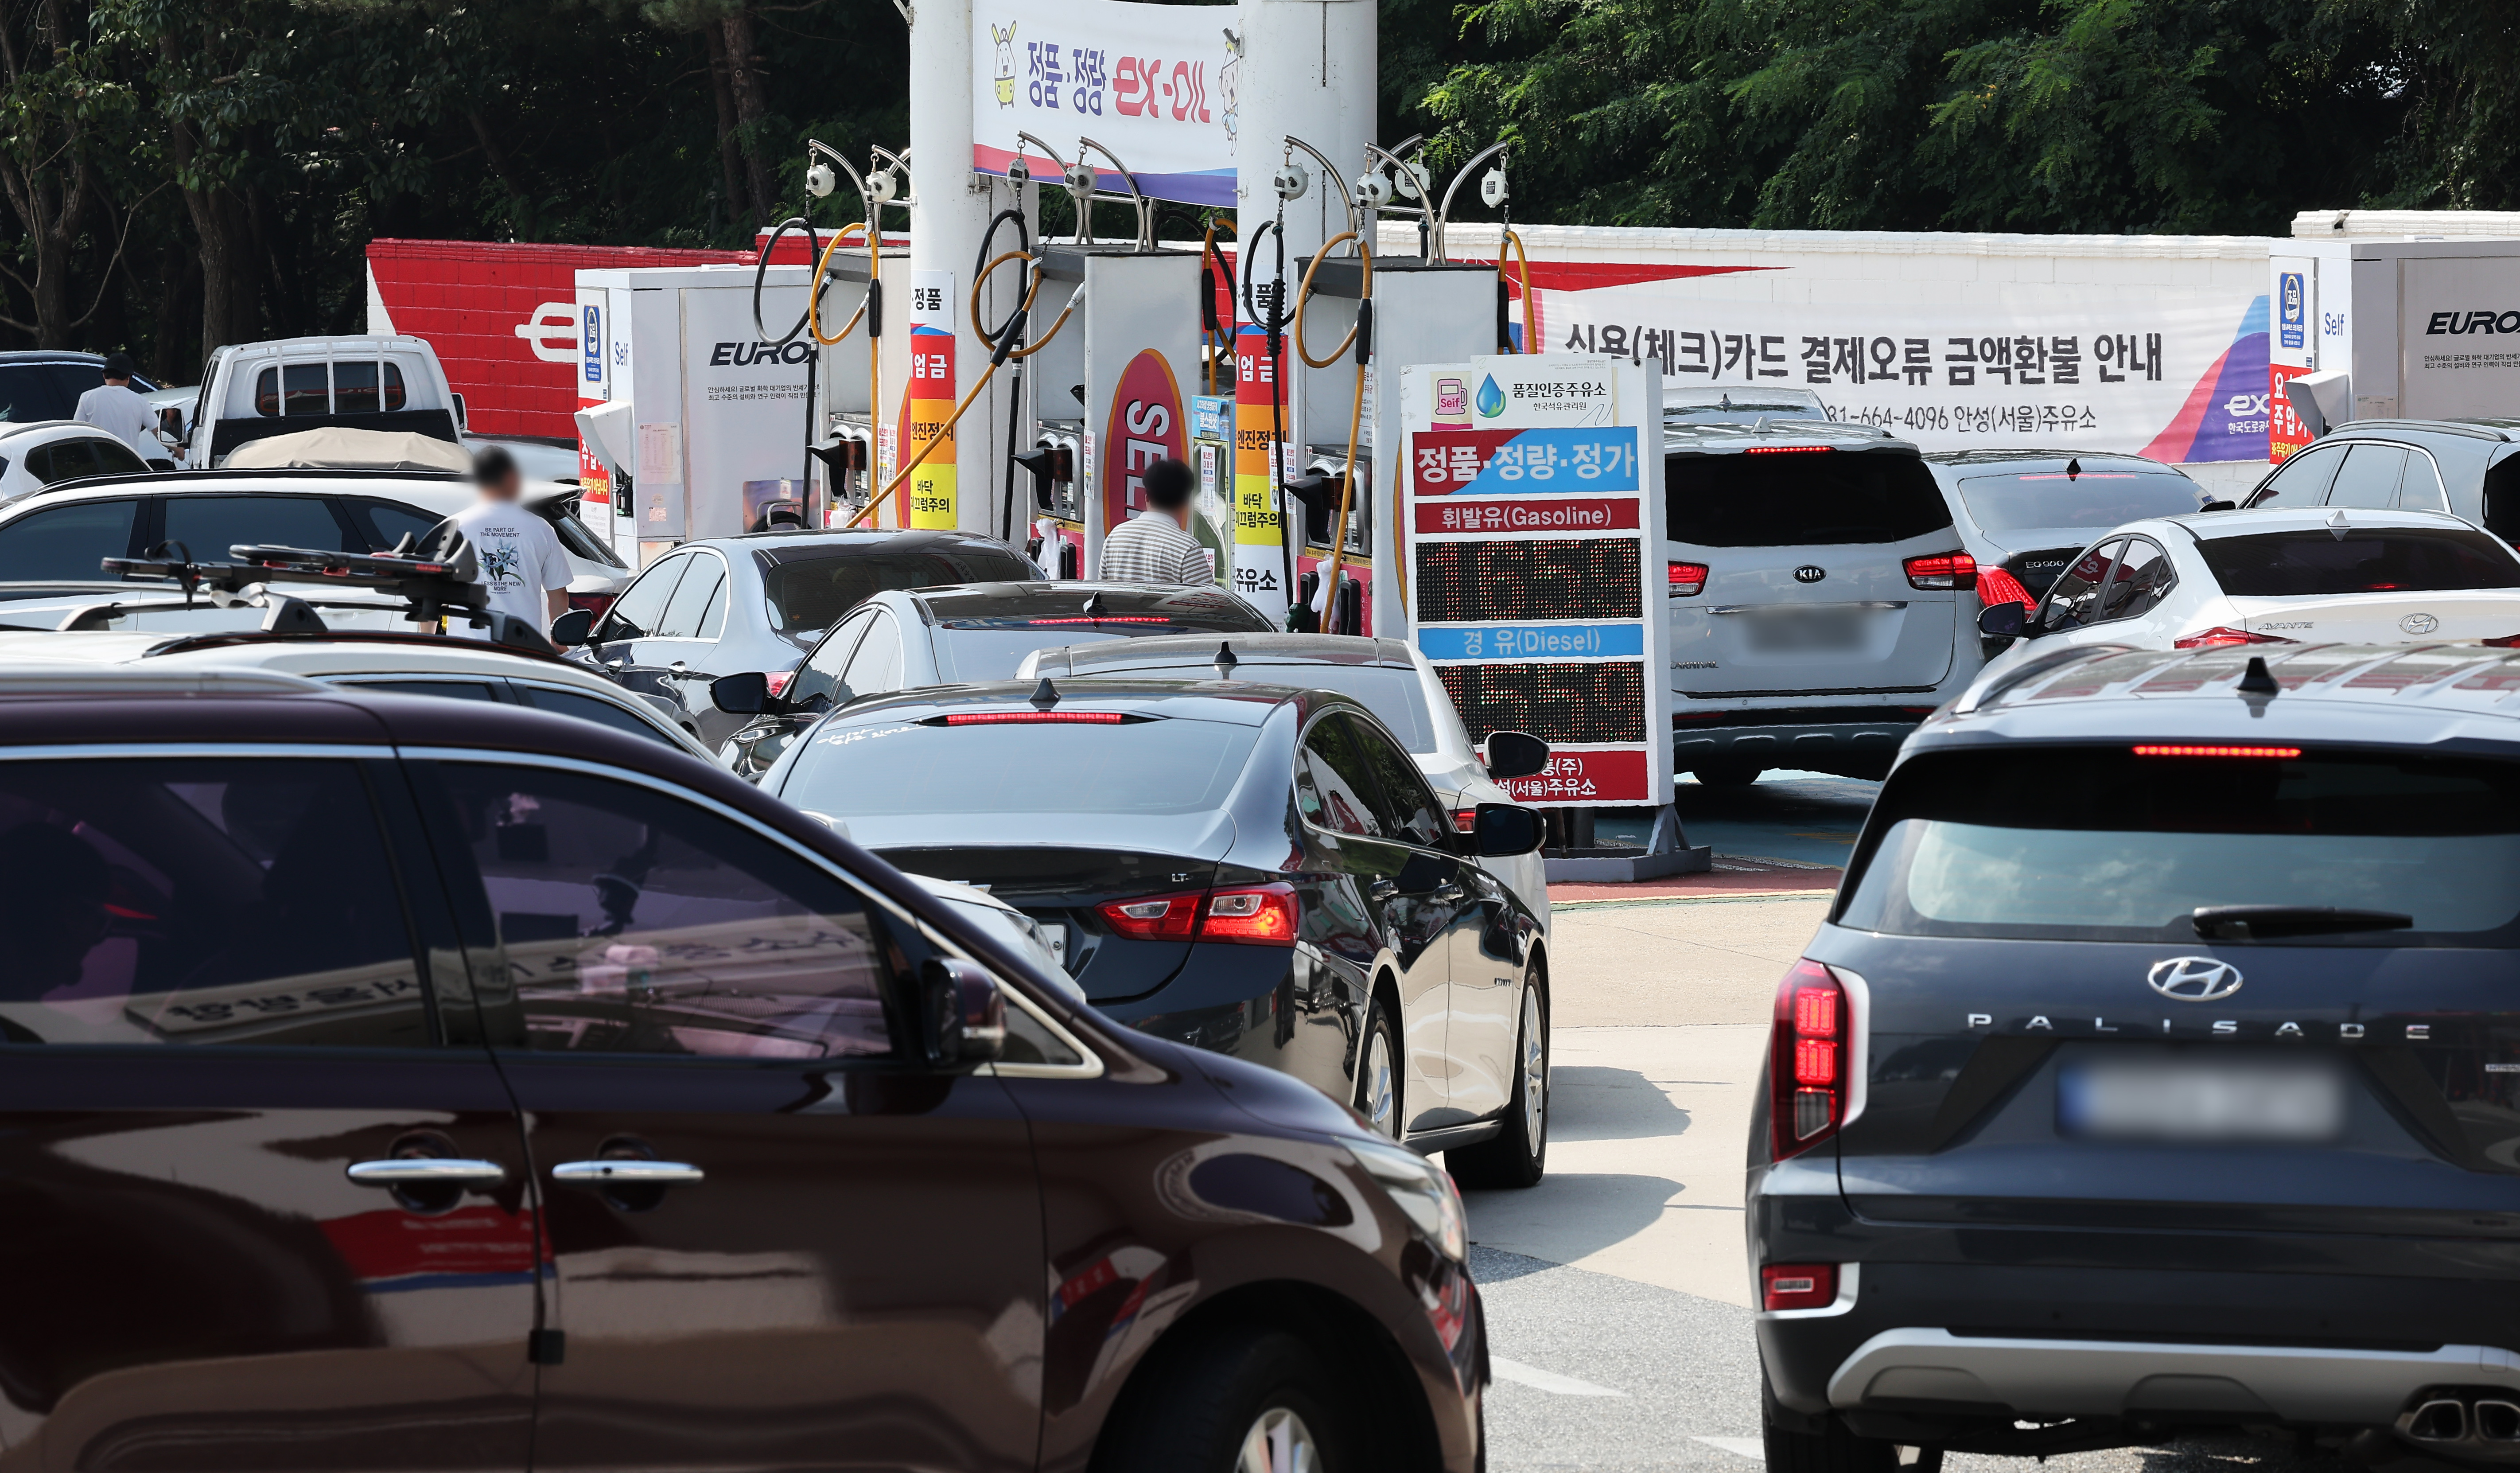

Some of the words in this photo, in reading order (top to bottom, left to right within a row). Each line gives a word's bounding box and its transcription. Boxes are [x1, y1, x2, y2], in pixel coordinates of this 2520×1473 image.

[2325, 312, 2345, 336] Self
[2426, 311, 2520, 335] EURO
[615, 341, 628, 366] Self
[710, 341, 819, 366] EURO
[1801, 336, 1933, 386] 결제오류
[1945, 335, 2082, 386] 금액환불
[2094, 333, 2162, 382] 안내
[1512, 382, 1607, 398] 품질인증주유소
[1533, 401, 1587, 412] 한국석유관리원
[2224, 394, 2270, 417] ex
[1200, 411, 1217, 429] 불스원샷
[1954, 405, 2097, 433] 안성(서울)주유소
[1125, 399, 1170, 519] SEL
[1417, 442, 1635, 483] 정품·정량·정가
[917, 479, 933, 495] 바닥
[1243, 493, 1263, 509] 바닥
[1442, 504, 1612, 530] 휘발유(Gasoline)
[1236, 568, 1278, 593] 주유소
[1798, 569, 1822, 580] KIA
[2258, 621, 2314, 631] AVANTE
[1670, 660, 1719, 669] CARNIVAL
[1541, 757, 1583, 776] 통(주)
[1172, 873, 1187, 882] LT
[1968, 1012, 2431, 1040] PALISADE
